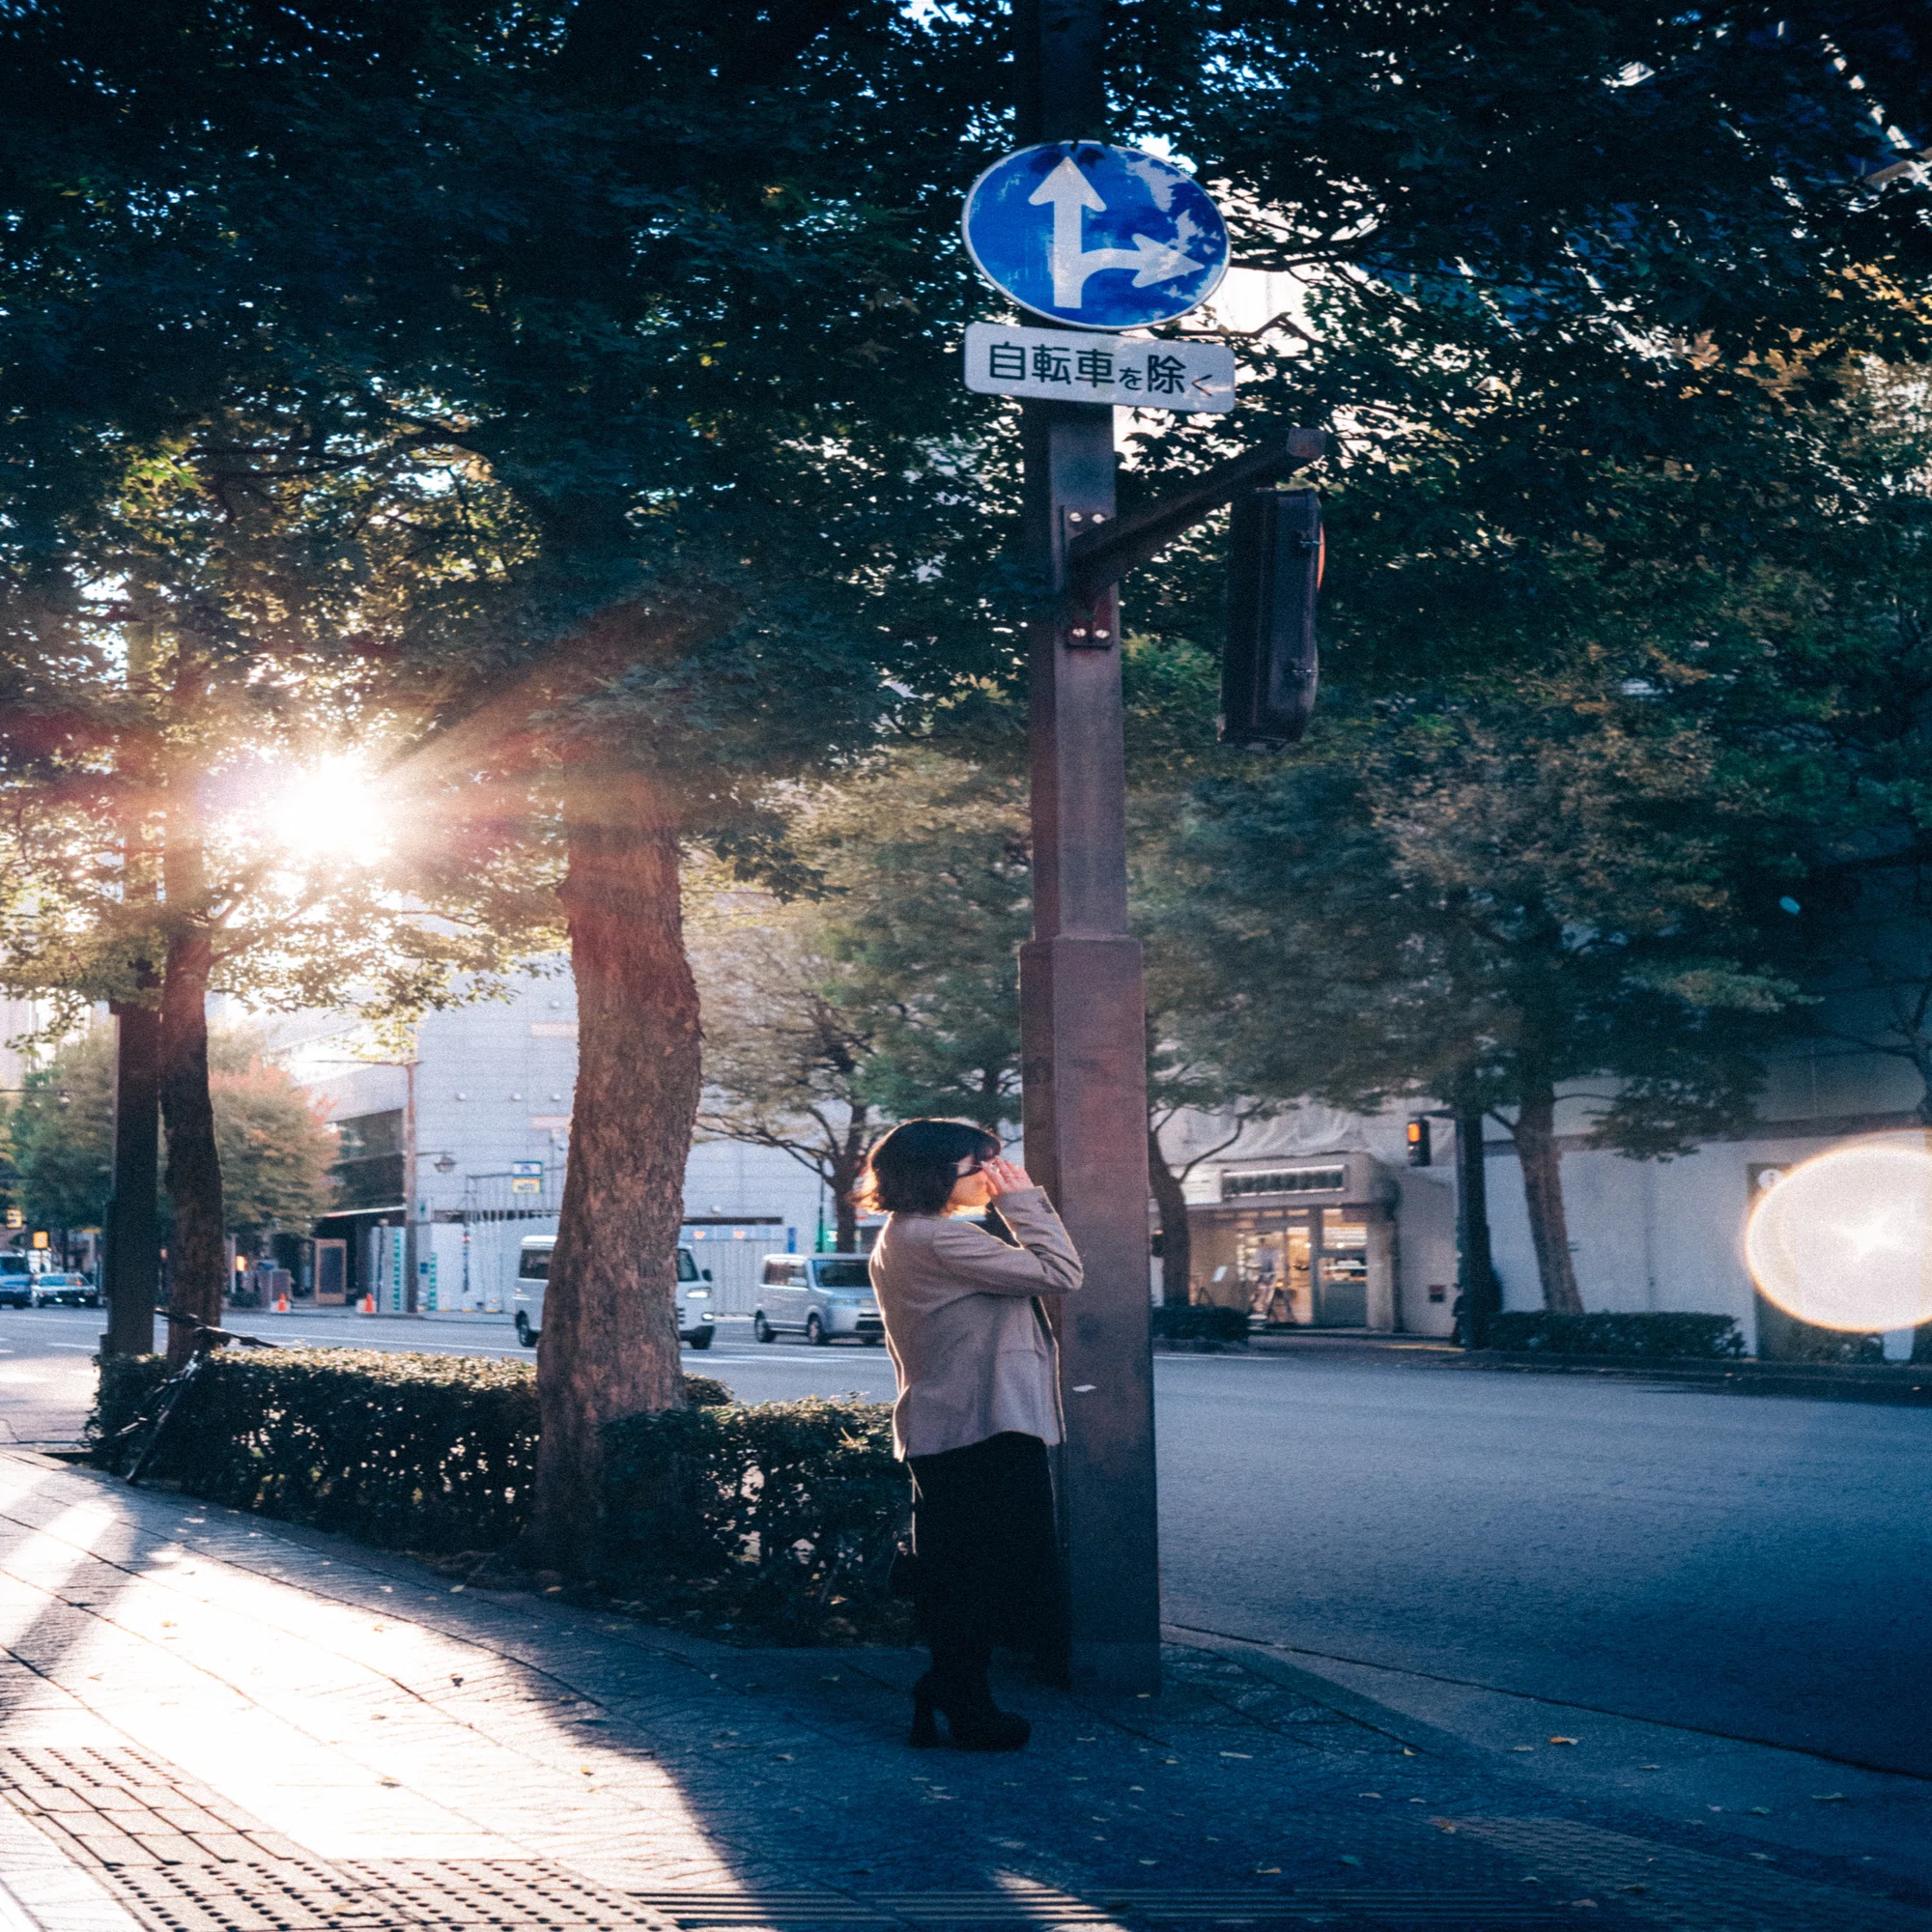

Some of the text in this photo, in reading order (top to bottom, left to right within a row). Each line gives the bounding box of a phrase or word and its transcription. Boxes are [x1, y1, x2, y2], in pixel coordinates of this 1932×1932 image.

[989, 341, 1213, 397] 自転車を除く
